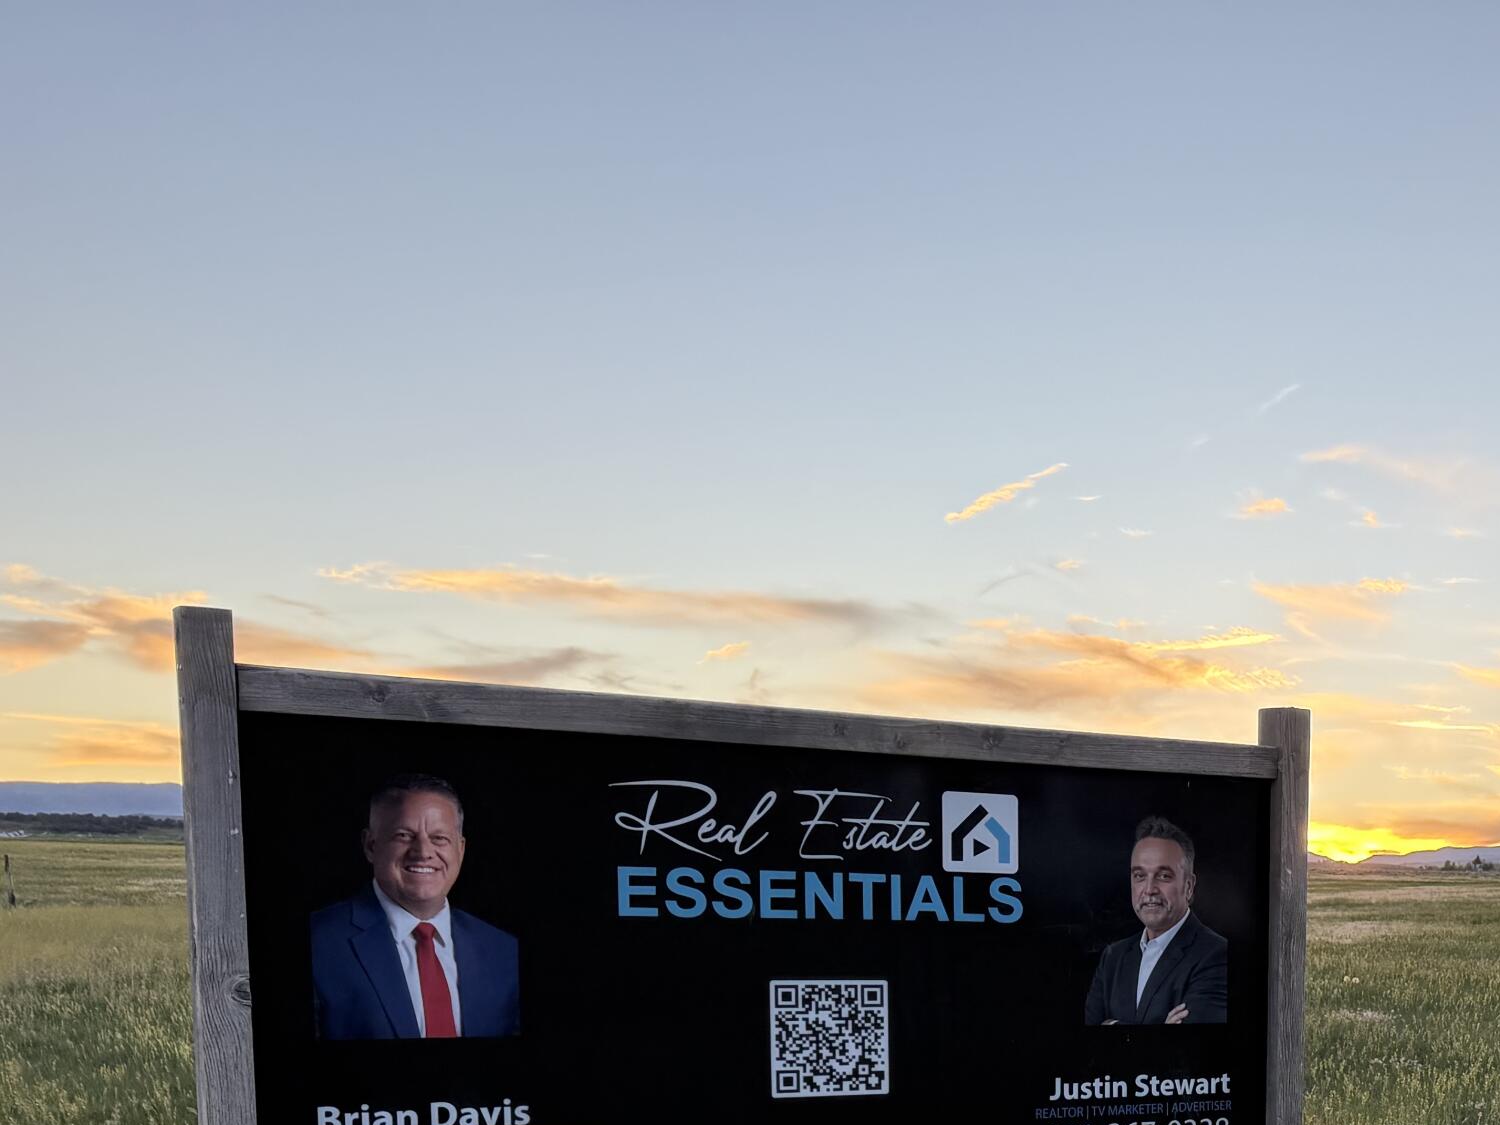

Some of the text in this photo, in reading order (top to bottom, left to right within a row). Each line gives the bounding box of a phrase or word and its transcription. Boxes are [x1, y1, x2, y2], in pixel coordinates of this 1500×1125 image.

[608, 780, 933, 862] Real Estate
[617, 866, 1024, 924] ESSENTIALS
[1049, 1073, 1231, 1101] Justin Stewart
[1035, 1106, 1084, 1120] REALTOR
[1091, 1105, 1105, 1117] TV
[1107, 1102, 1164, 1116] MARKETER
[1171, 1100, 1232, 1113] ADVERTISER
